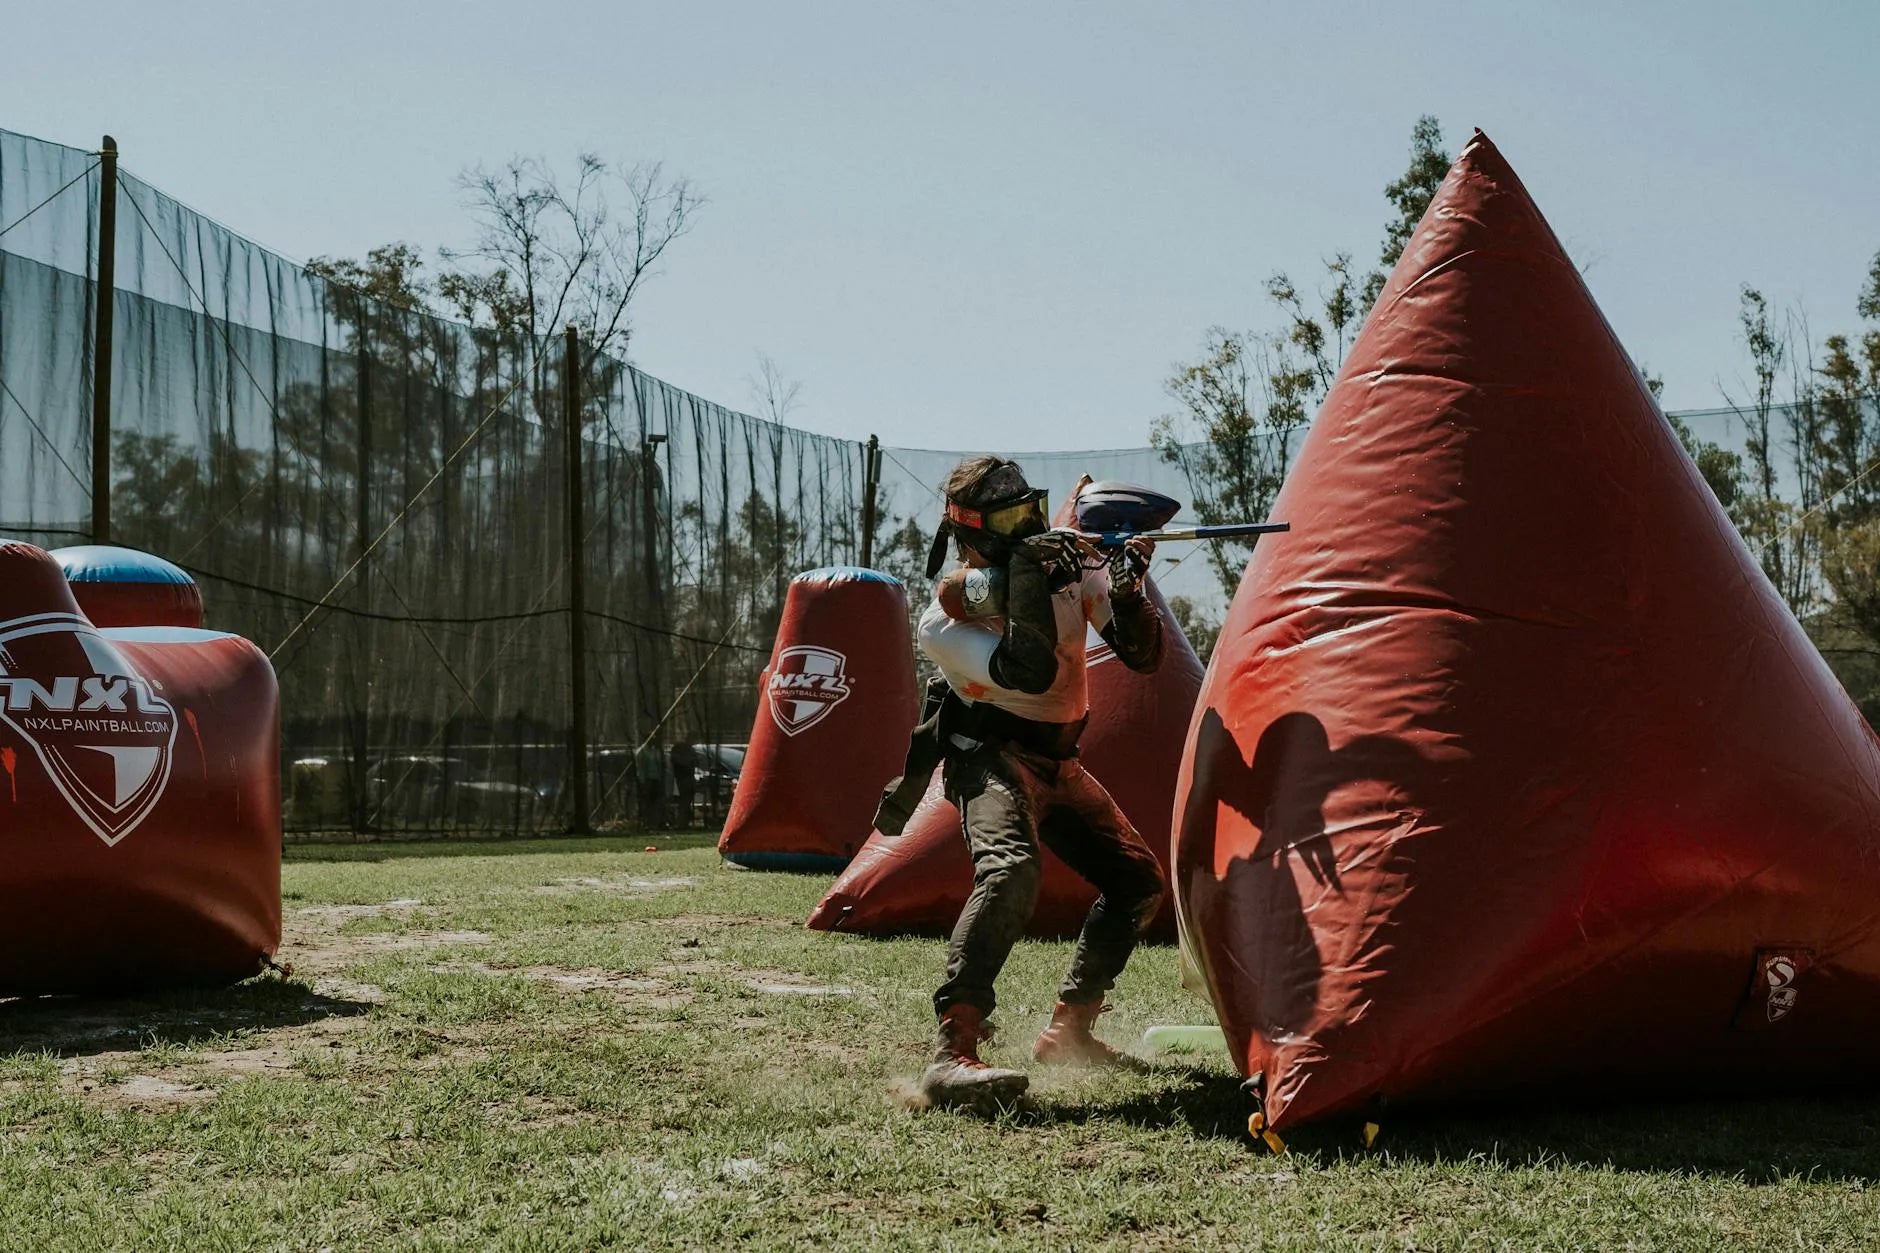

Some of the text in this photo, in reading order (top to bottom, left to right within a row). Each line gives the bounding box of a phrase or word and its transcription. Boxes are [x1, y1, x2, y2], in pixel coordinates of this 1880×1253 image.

[771, 673, 846, 693] NXL
[0, 676, 170, 714] NXL
[24, 717, 170, 733] NXLPAINTBALL.COM
